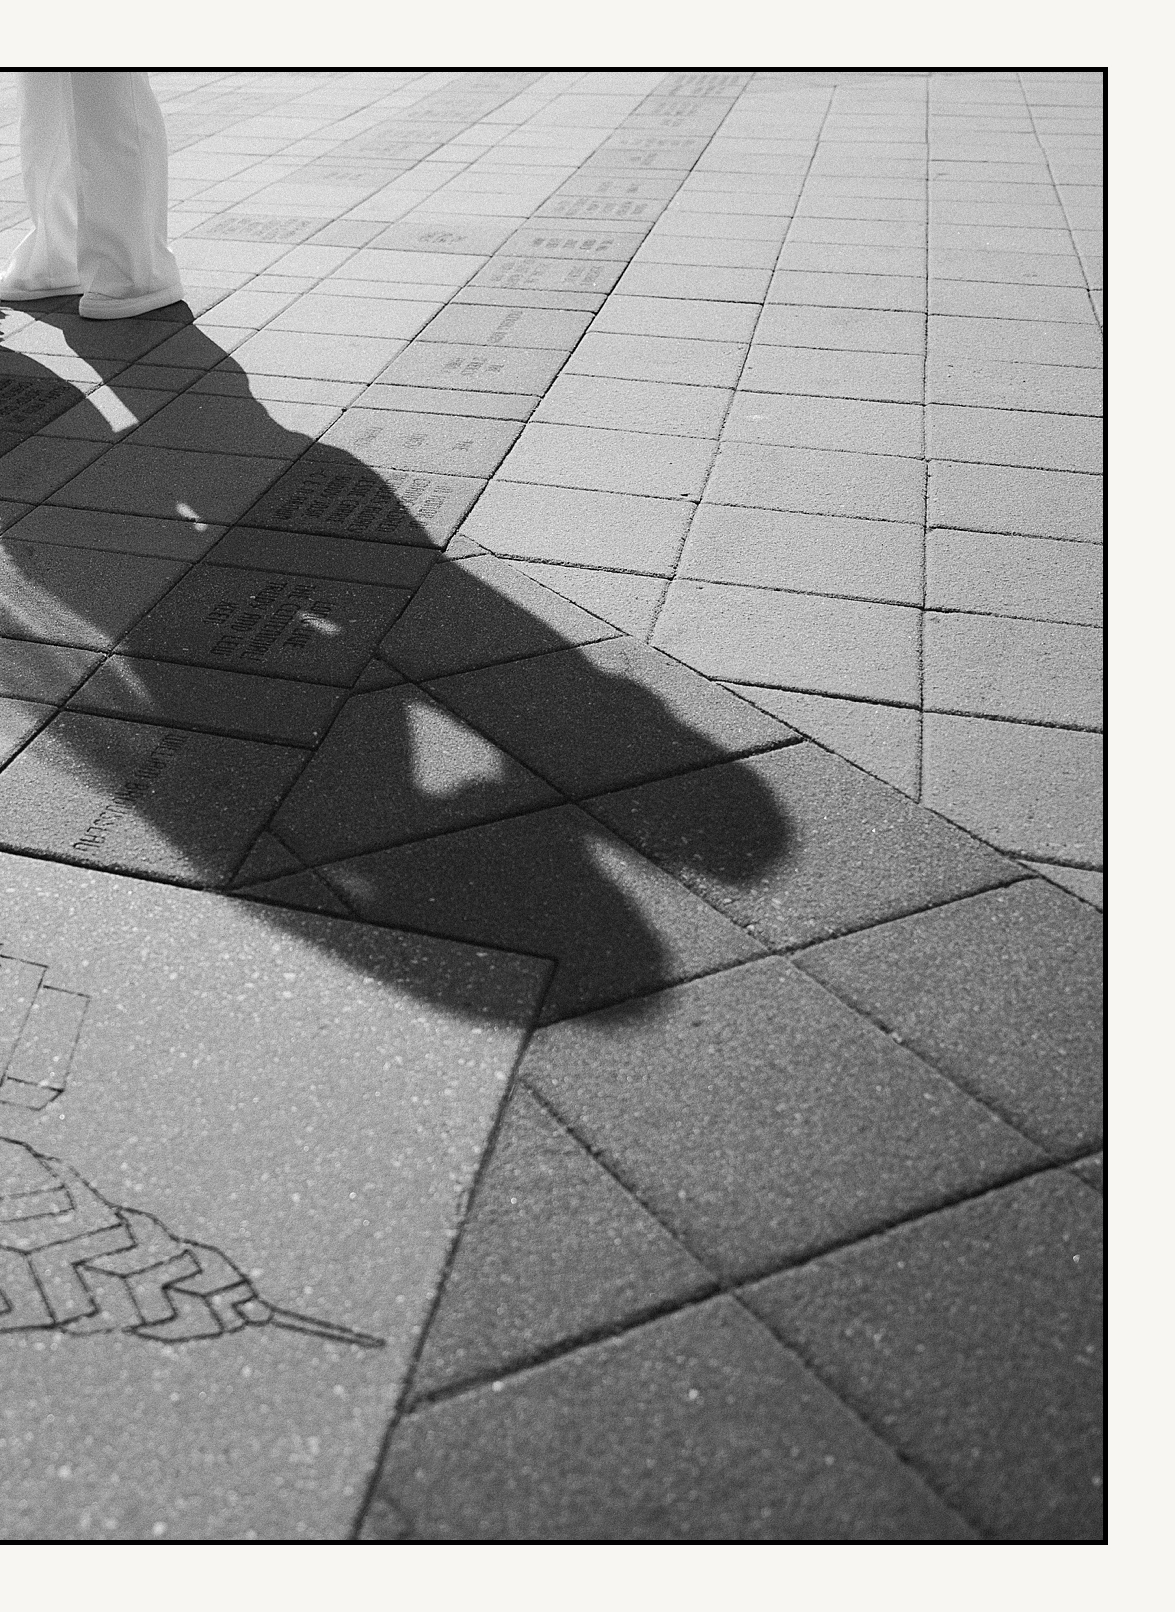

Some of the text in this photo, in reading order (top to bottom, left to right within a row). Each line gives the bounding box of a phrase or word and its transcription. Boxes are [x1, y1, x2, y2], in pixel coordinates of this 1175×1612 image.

[285, 583, 316, 600] THE
[207, 580, 288, 656] TRUDY AND LEW
[280, 627, 316, 649] LIVE
